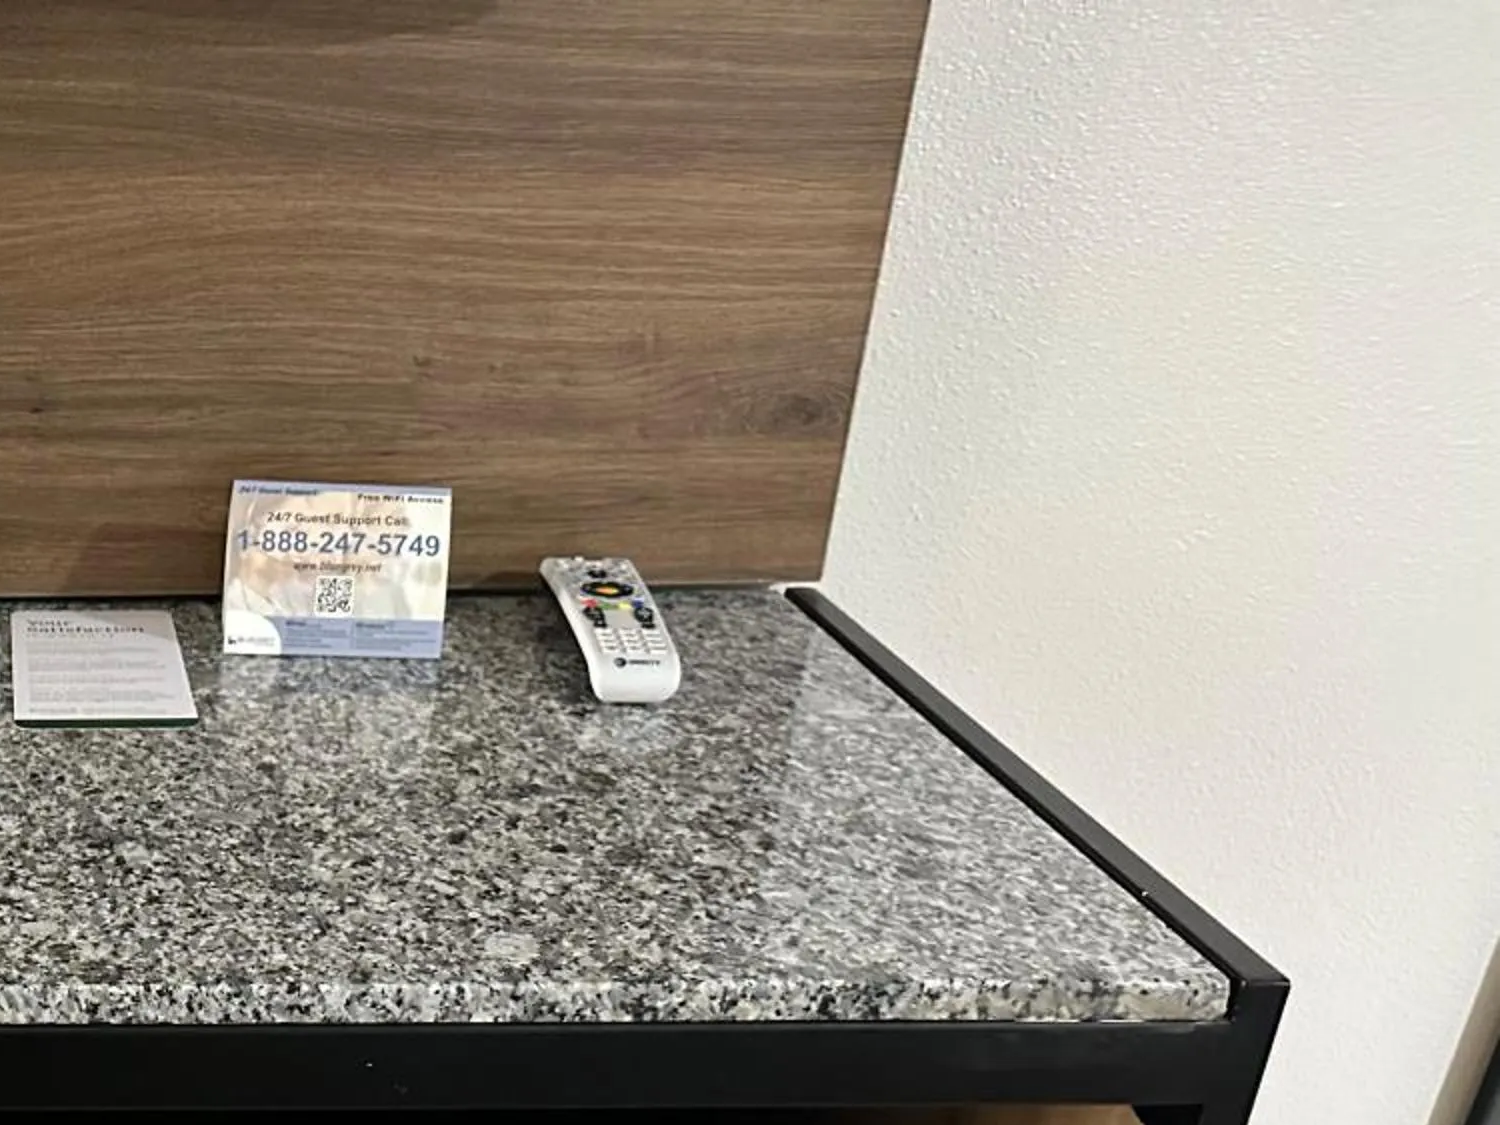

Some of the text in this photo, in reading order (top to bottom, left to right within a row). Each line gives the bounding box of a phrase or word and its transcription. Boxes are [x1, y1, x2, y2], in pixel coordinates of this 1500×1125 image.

[266, 511, 292, 523] 24/7
[294, 513, 330, 525] Guest
[333, 514, 382, 527] Support
[237, 529, 441, 557] 1-888-247-5749
